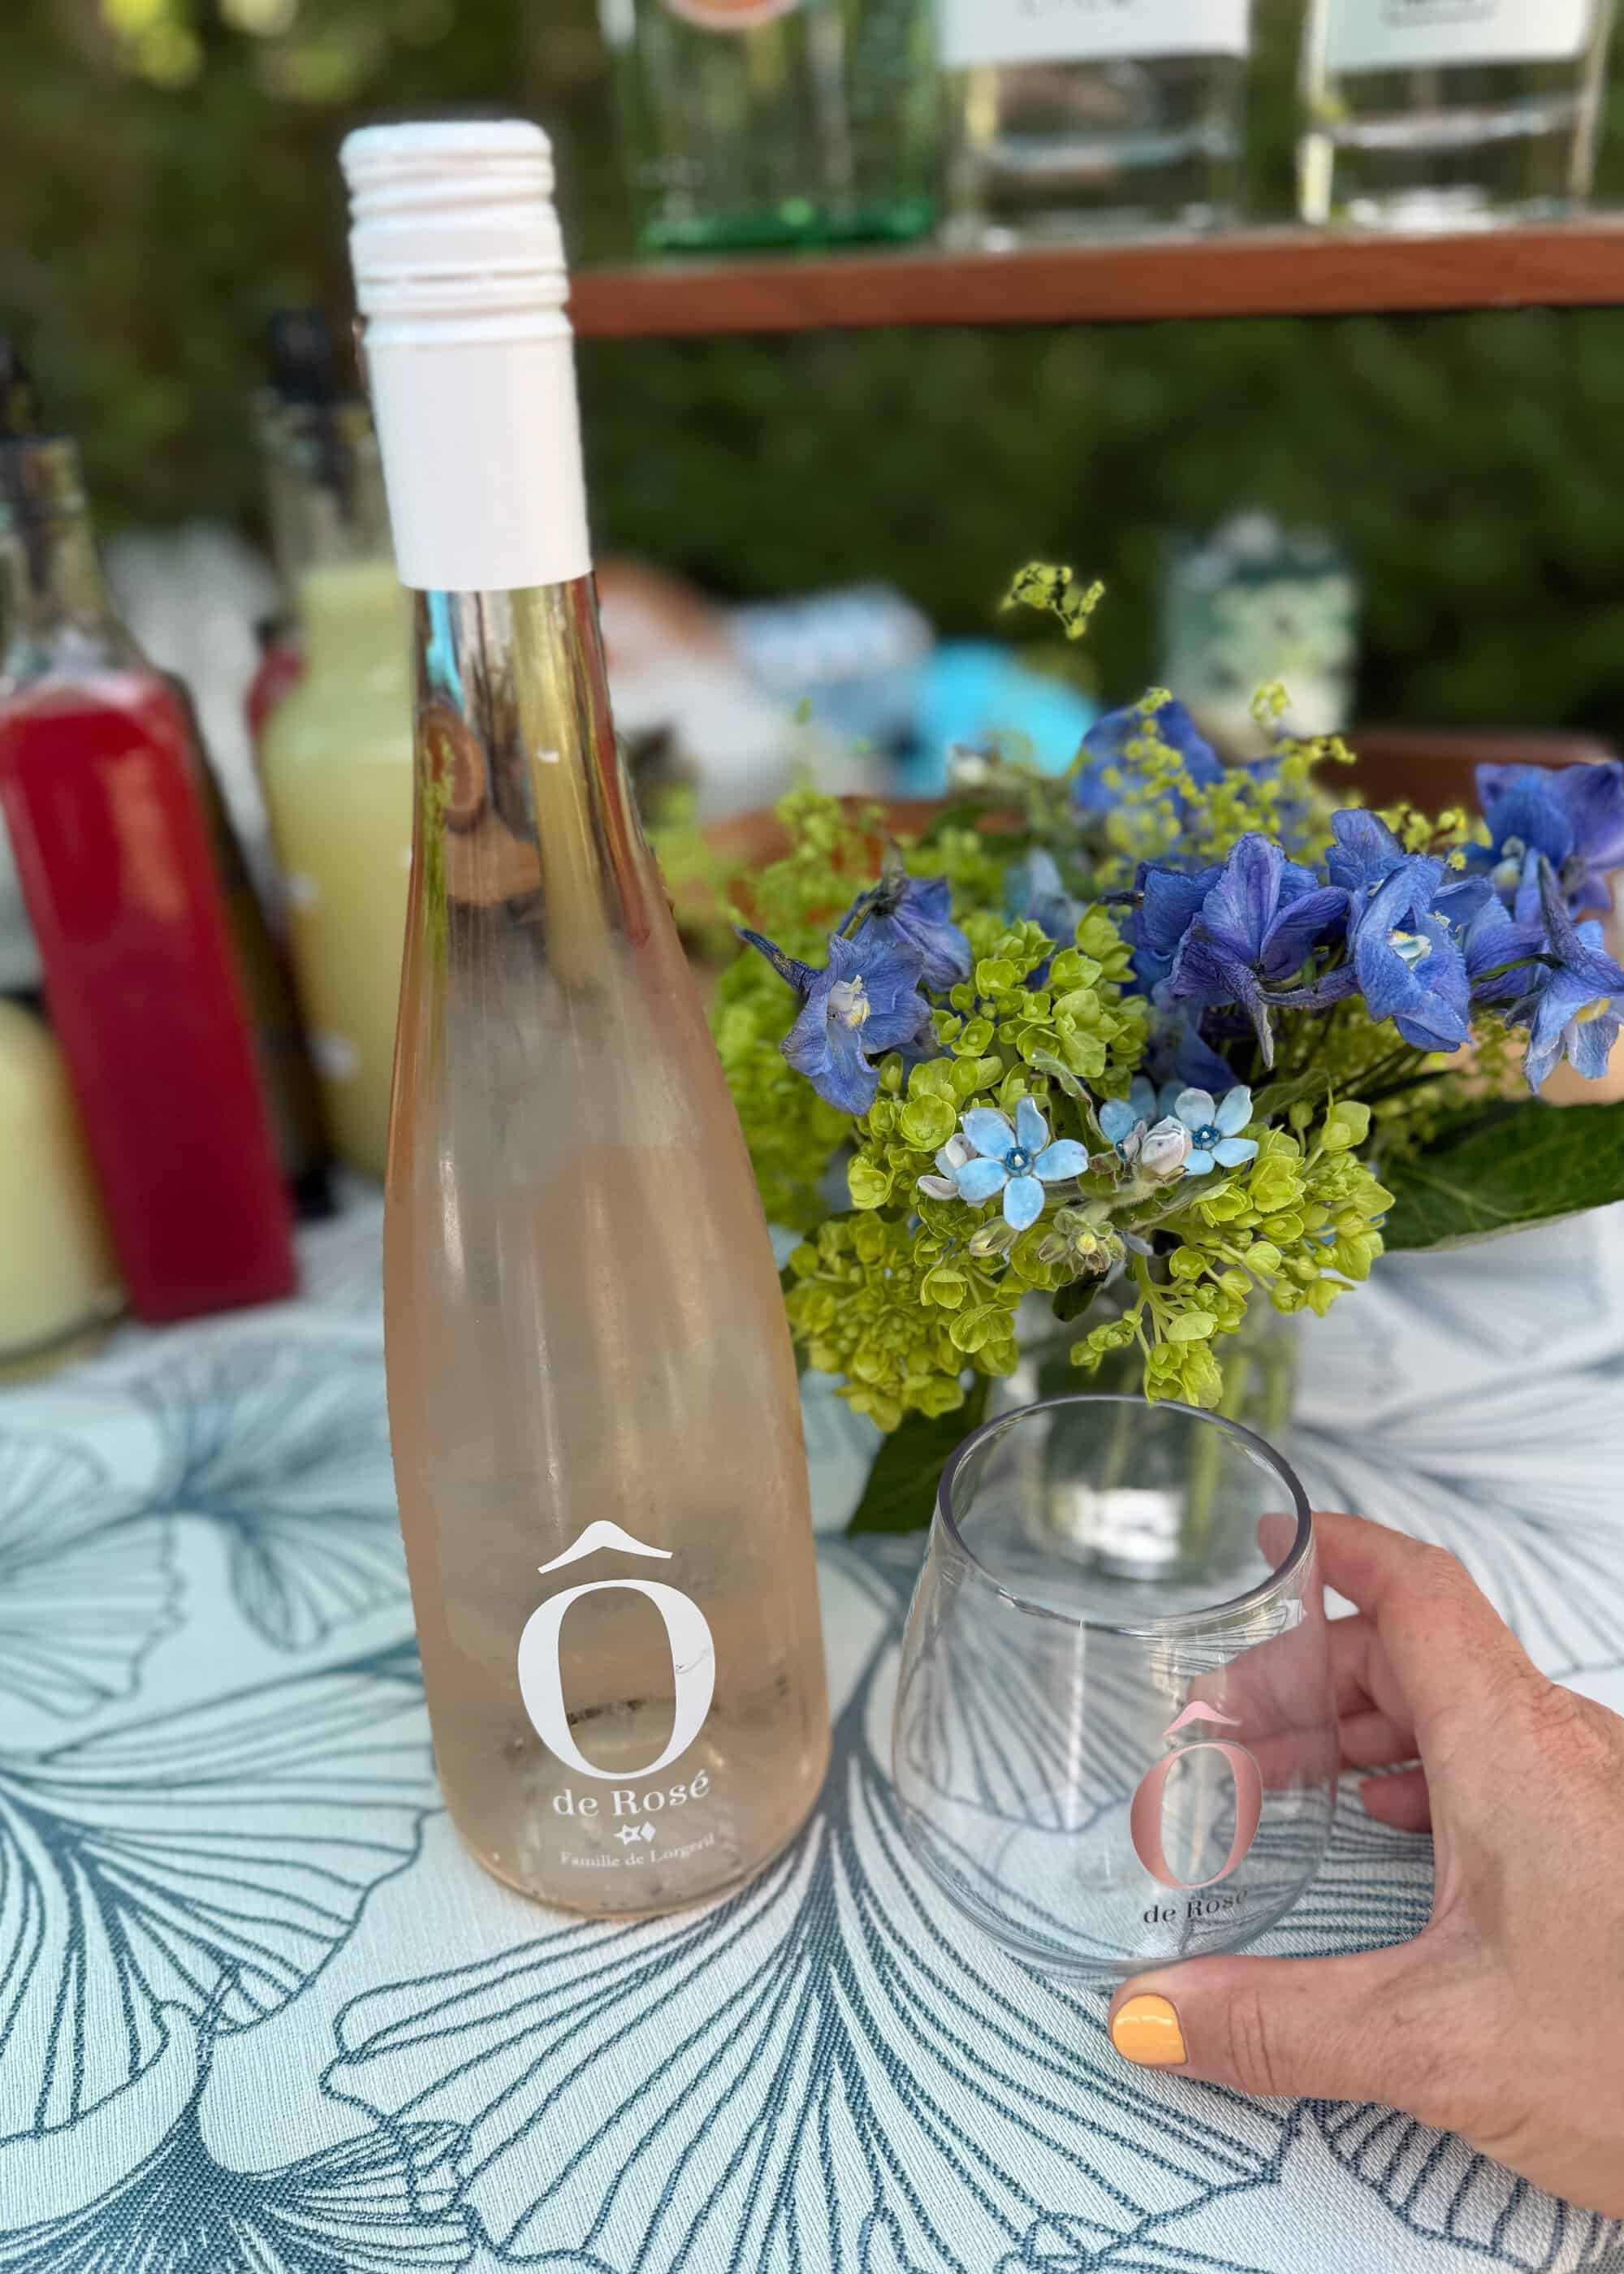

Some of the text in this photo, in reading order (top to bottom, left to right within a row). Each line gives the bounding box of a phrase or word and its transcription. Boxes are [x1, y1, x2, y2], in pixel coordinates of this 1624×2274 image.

[517, 1520, 715, 1779] Ô
[552, 1768, 710, 1818] de Rosé
[1129, 1701, 1263, 1890] Ô
[560, 1850, 620, 1867] Famille
[624, 1848, 645, 1866] de
[1142, 1904, 1177, 1924] de
